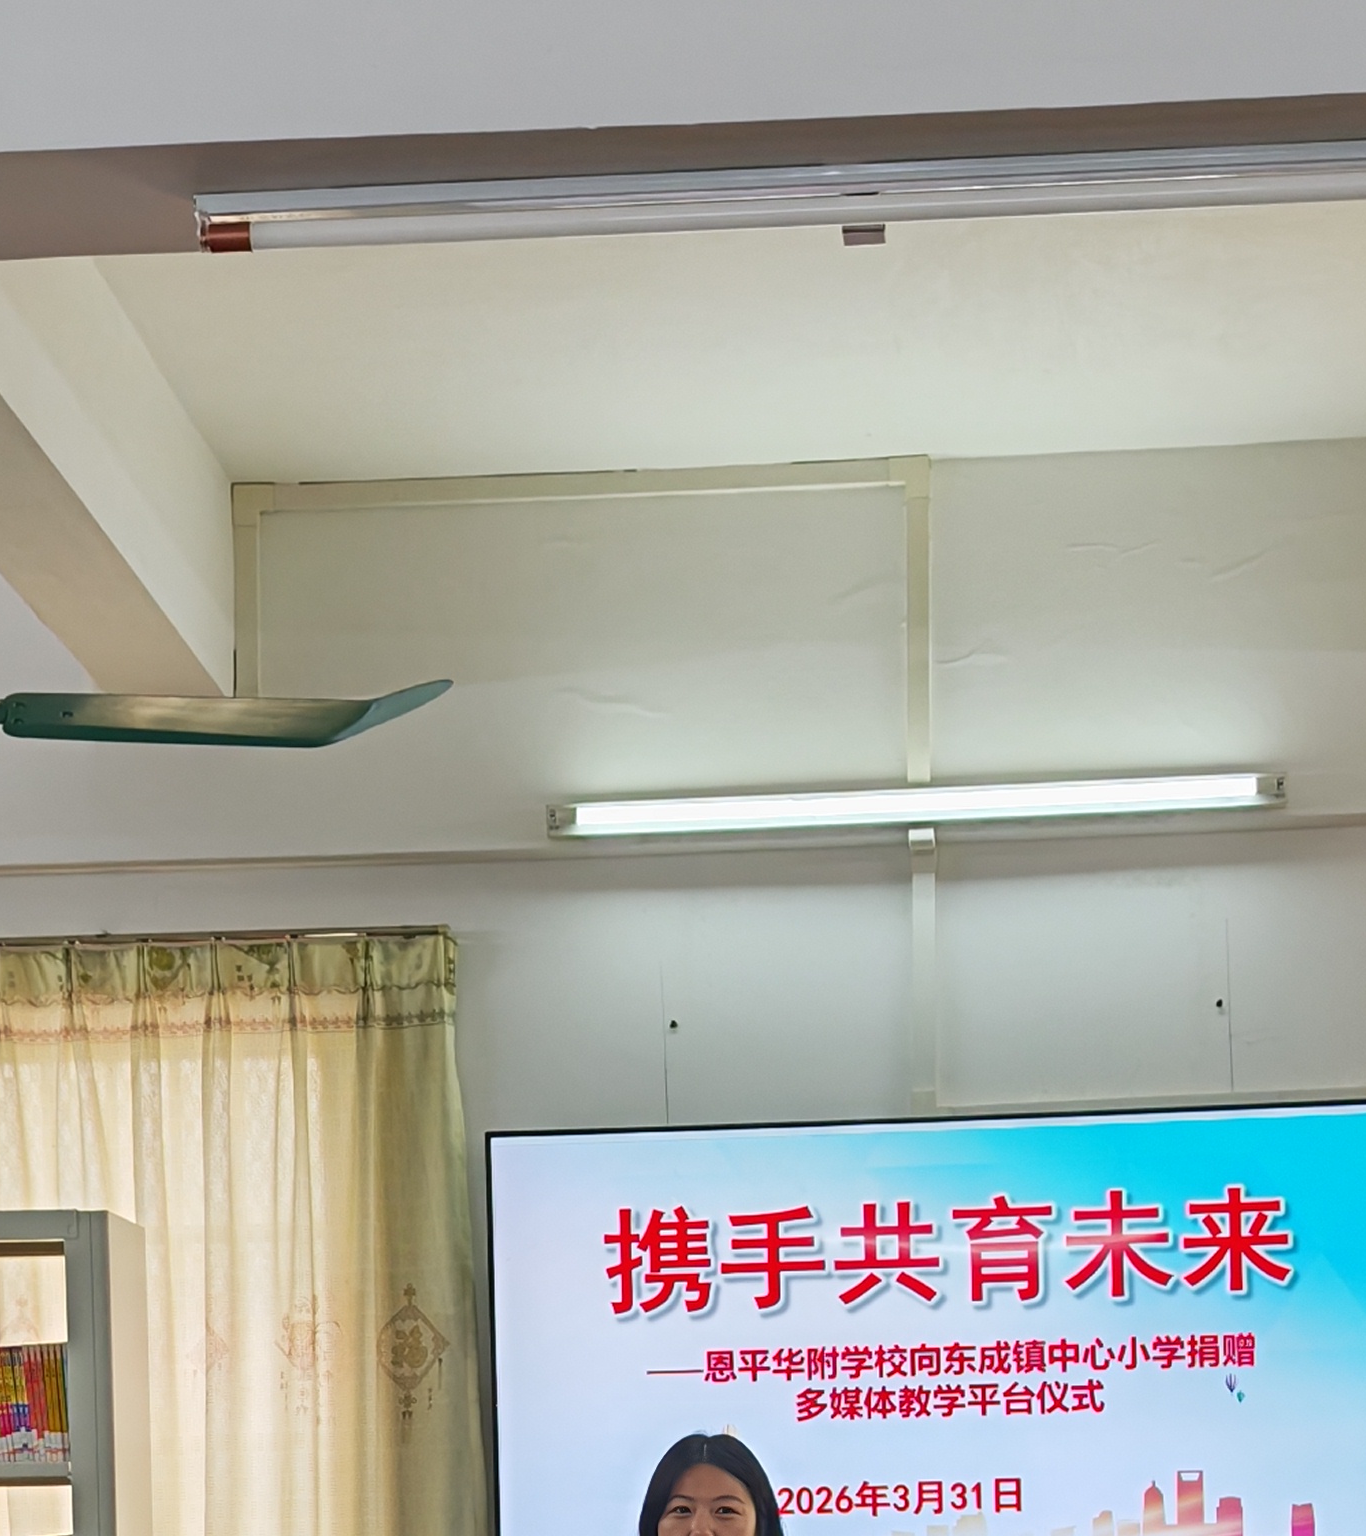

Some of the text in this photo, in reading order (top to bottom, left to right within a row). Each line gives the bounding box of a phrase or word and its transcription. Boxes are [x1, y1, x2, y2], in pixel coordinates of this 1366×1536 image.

[602, 1186, 1290, 1315] 携手共育未来
[795, 1377, 1106, 1421] 多媒体教学平台仪式
[775, 1477, 1022, 1517] 2026年3月31日
